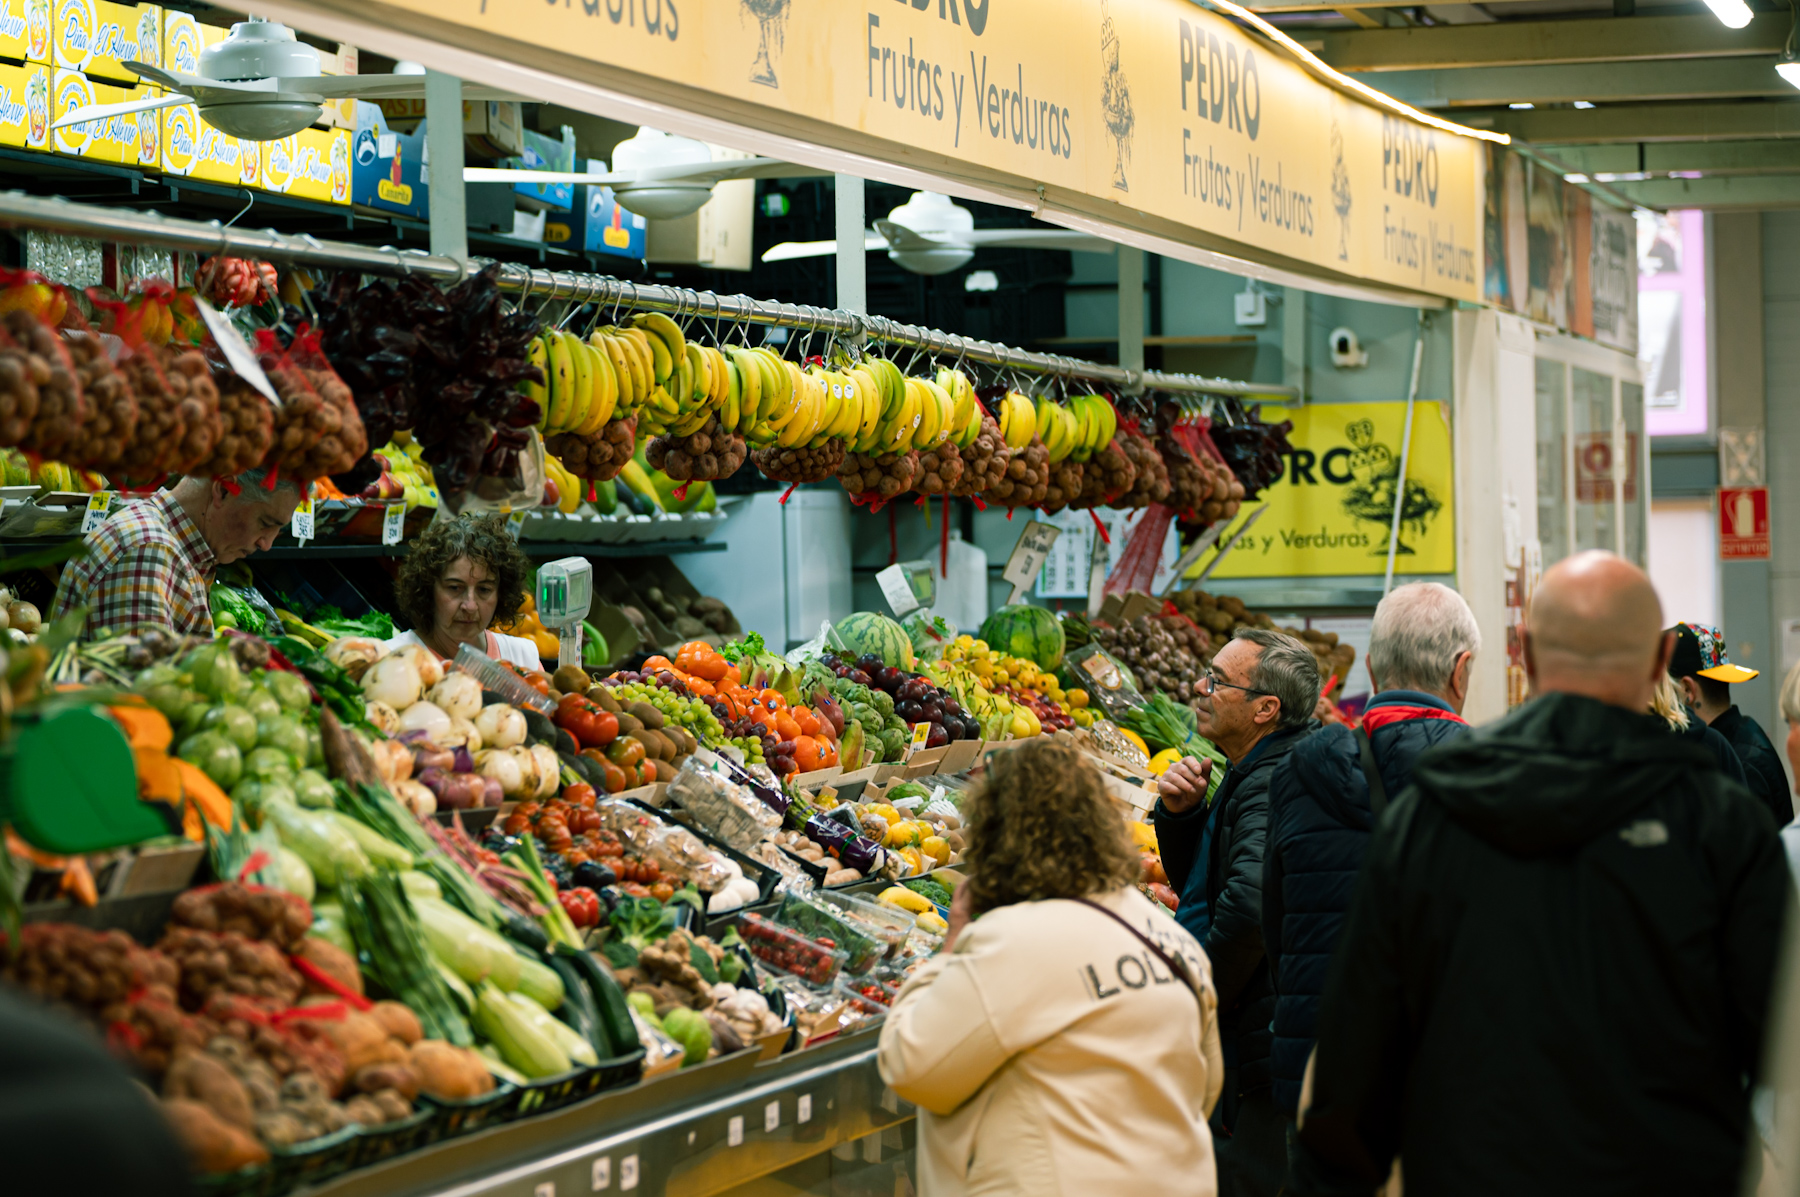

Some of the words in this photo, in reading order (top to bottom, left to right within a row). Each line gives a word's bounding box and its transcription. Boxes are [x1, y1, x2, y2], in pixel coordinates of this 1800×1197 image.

[868, 12, 944, 121] Frutas
[951, 71, 964, 148] y
[970, 50, 1071, 159] Verduras
[1179, 18, 1260, 141] PEDRO
[1183, 127, 1231, 211] Frutas
[1236, 170, 1245, 232] y
[1248, 152, 1314, 237] Verduras
[1383, 113, 1438, 209] PEDRO
[1384, 204, 1418, 269] Frutas
[1420, 234, 1428, 286] y
[1429, 218, 1475, 285] Verduras
[1261, 535, 1274, 556] y
[1280, 525, 1370, 549] Verduras
